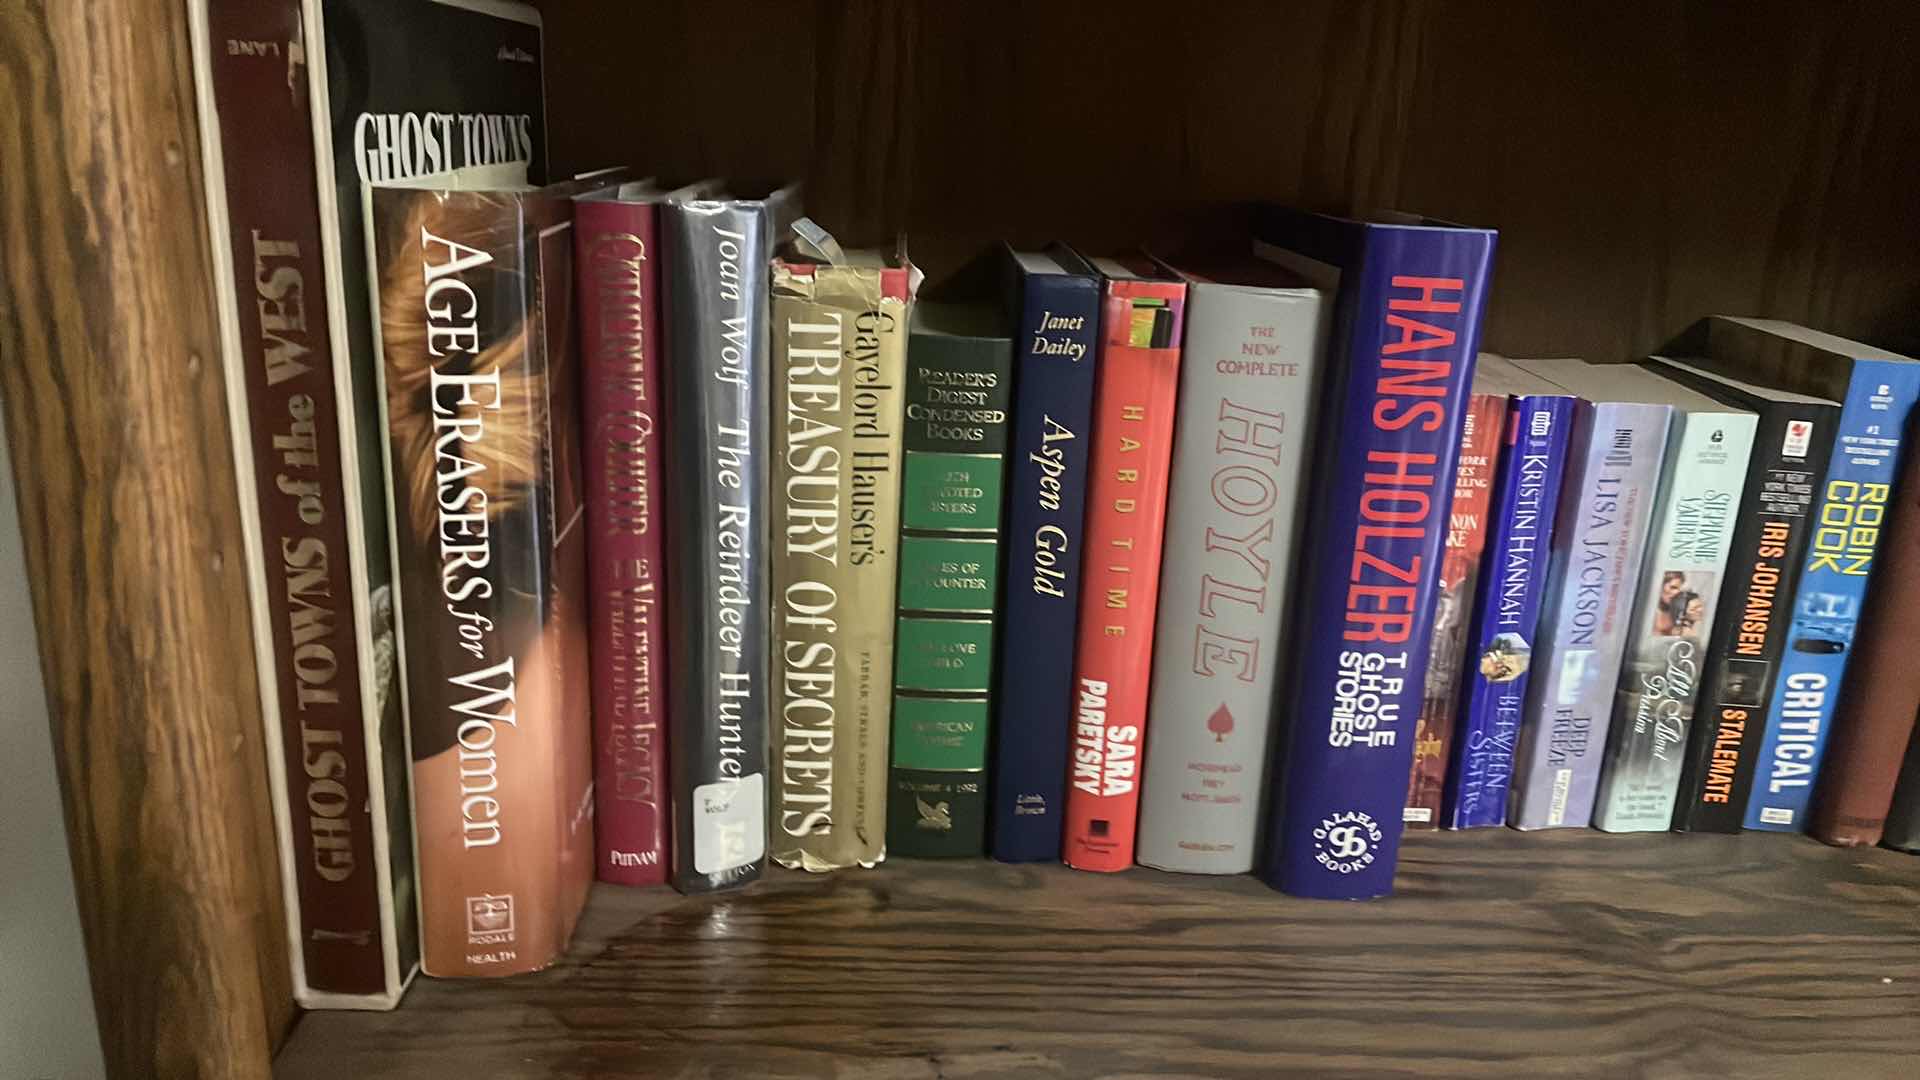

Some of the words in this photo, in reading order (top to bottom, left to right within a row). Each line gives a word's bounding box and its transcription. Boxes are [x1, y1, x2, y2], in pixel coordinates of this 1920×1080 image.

[354, 111, 454, 185] GHOST
[250, 228, 315, 387] WEST
[420, 225, 495, 358] AGE
[712, 225, 747, 302] Joan
[713, 315, 750, 391] Wolf
[1031, 337, 1088, 362] Dailey
[1034, 311, 1085, 334] Janet
[1215, 359, 1300, 377] COMPLETE
[1240, 342, 1280, 357] NEW
[1249, 325, 1276, 339] THE
[1372, 274, 1465, 432] HANS
[845, 309, 896, 440] Gayelord
[906, 403, 1006, 424] CONDENSED
[918, 367, 998, 388] READER'S
[927, 386, 988, 406] DIGEST
[272, 393, 321, 468] the
[717, 417, 752, 490] The
[785, 311, 843, 569] TREASURY
[927, 422, 985, 441] BOOKS
[1029, 413, 1077, 511] Aspen
[1112, 404, 1146, 514] HARD
[276, 472, 325, 525] of
[429, 364, 501, 602] ERASERS
[850, 450, 890, 567] Hauser's
[1512, 454, 1550, 530] KRISTIN
[1590, 477, 1622, 529] LISA
[1807, 480, 1861, 574] COOK
[1841, 482, 1891, 576] ROBIN
[718, 502, 751, 659] Reindeer
[1032, 524, 1069, 599] Gold
[1193, 397, 1286, 683] HOYLE
[1343, 449, 1438, 643] HOLZER
[1497, 535, 1537, 625] HANNAH
[1757, 521, 1791, 558] IRIS
[281, 536, 340, 711] TOWNS
[447, 602, 495, 661] for
[784, 580, 839, 634] Of
[1103, 537, 1134, 637] TIME
[1570, 537, 1609, 645] JACKSON
[1735, 562, 1781, 656] JOHANSEN
[780, 639, 837, 838] SECRETS
[1073, 677, 1109, 797] PARETSKY
[1327, 650, 1363, 748] STORIES
[1352, 651, 1386, 748] GHOST
[1374, 651, 1408, 747] TRUE
[1573, 716, 1591, 758] DEEP
[1768, 672, 1829, 794] CRITICAL
[446, 655, 518, 850] Women
[1102, 724, 1138, 798] SARA
[1703, 708, 1748, 805] STALEMATE
[300, 719, 357, 883] GHOST
[1312, 811, 1383, 842] GALAHAD
[1315, 851, 1375, 874] BOOKS
